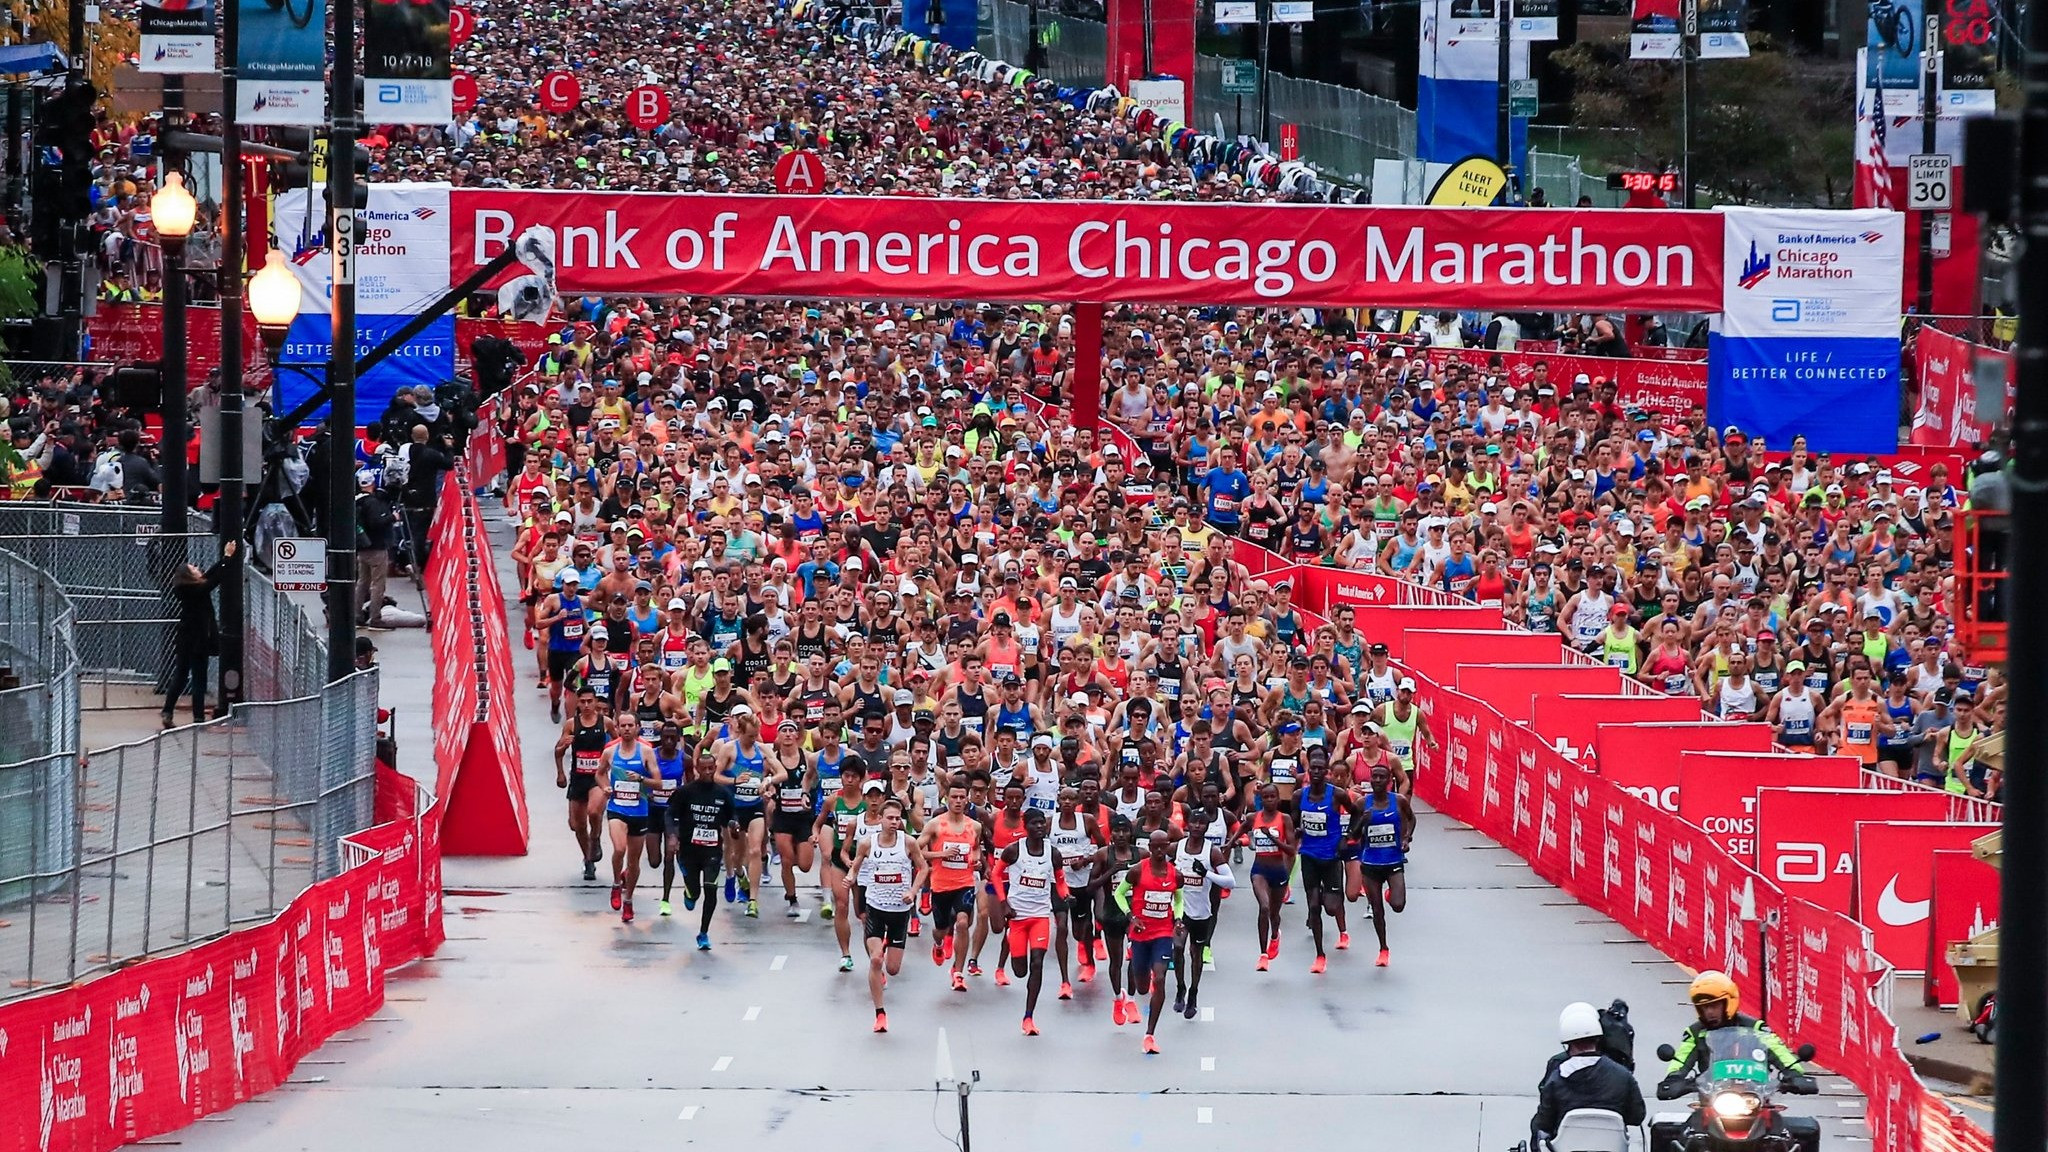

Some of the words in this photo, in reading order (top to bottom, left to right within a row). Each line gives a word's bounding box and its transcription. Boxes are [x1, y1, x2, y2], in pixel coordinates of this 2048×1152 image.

[1945, 17, 1992, 45] GO
[248, 62, 316, 71] #ChicagoMarathon
[451, 74, 467, 101] C
[550, 75, 569, 101] C
[639, 90, 659, 117] B
[1140, 97, 1179, 106] aggreko
[1913, 158, 1948, 169] SPEED
[785, 154, 813, 188] A
[1916, 169, 1944, 180] LIMIT
[1462, 170, 1493, 186] ALERT
[1459, 181, 1489, 198] LEVEL
[1914, 182, 1947, 202] 30
[368, 212, 409, 221] America
[1778, 234, 1803, 244] Bank
[1804, 234, 1814, 244] of
[1815, 234, 1856, 244] America
[355, 243, 406, 255] rathon
[665, 212, 739, 271] of
[758, 214, 1040, 277] America
[1067, 220, 1337, 297] Chicago
[1366, 225, 1694, 287] Marathon
[1777, 249, 1838, 266] Chicago
[1777, 266, 1853, 279] Marathon
[357, 329, 374, 340] FE
[286, 344, 332, 354] BETTE
[1786, 352, 1818, 363] LIFE
[1826, 351, 1833, 363] /
[1637, 372, 1661, 385] Bank
[1661, 376, 1671, 387] of
[1732, 367, 1787, 379] BETTER
[1795, 367, 1887, 380] CONNECTED
[1636, 389, 1692, 412] Chicago
[277, 583, 295, 591] TOW
[299, 583, 323, 591] ZONE
[1337, 583, 1350, 597] Bank
[1355, 586, 1374, 600] America
[1791, 721, 1803, 729] 514
[1582, 743, 1597, 758] A
[1035, 800, 1049, 808] 479
[1304, 821, 1319, 830] PACE
[1703, 816, 1755, 834] CONS
[1369, 835, 1386, 843] PACE
[1836, 852, 1853, 874] A
[878, 875, 896, 883] RUPP
[1725, 1064, 1744, 1074] TV
